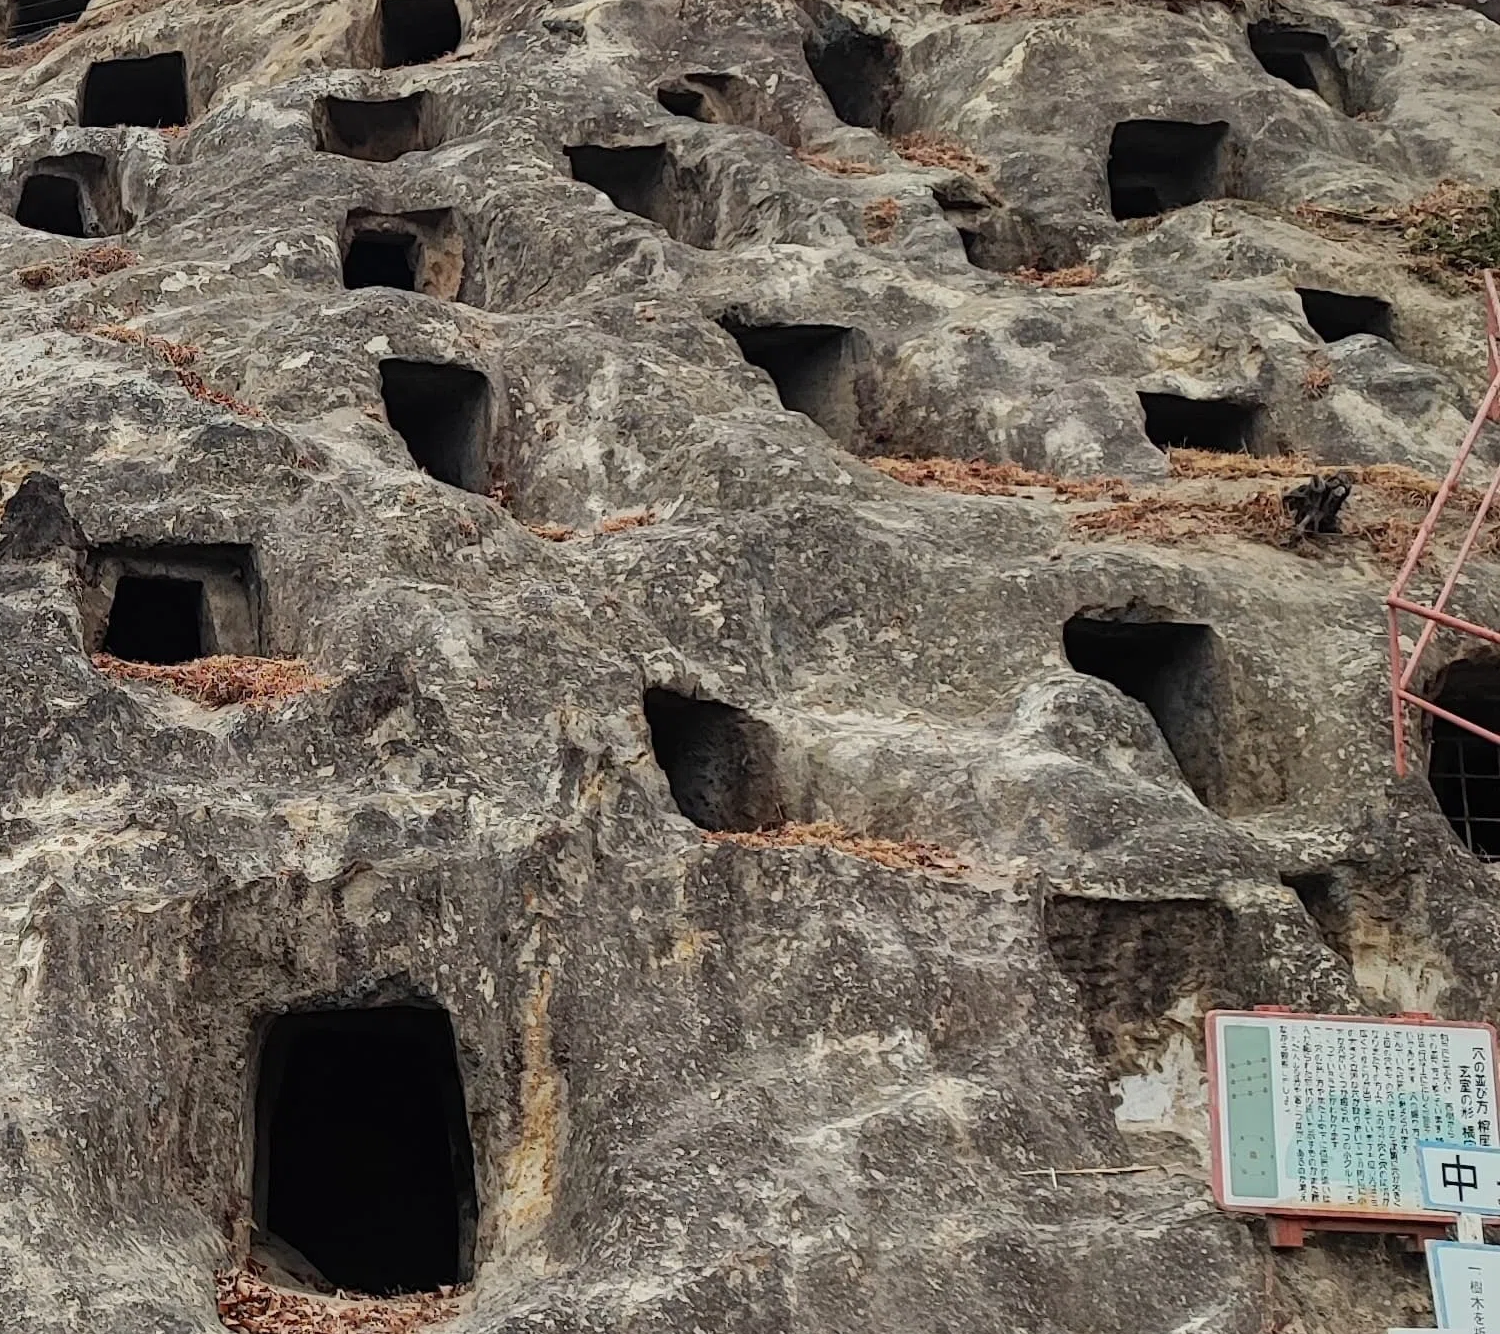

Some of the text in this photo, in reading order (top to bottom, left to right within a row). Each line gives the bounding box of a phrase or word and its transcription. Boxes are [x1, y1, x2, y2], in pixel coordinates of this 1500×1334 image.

[1459, 1065, 1474, 1119] 玄室の形
[1472, 1048, 1489, 1114] 穴の並び方
[1441, 1154, 1500, 1204] 中
